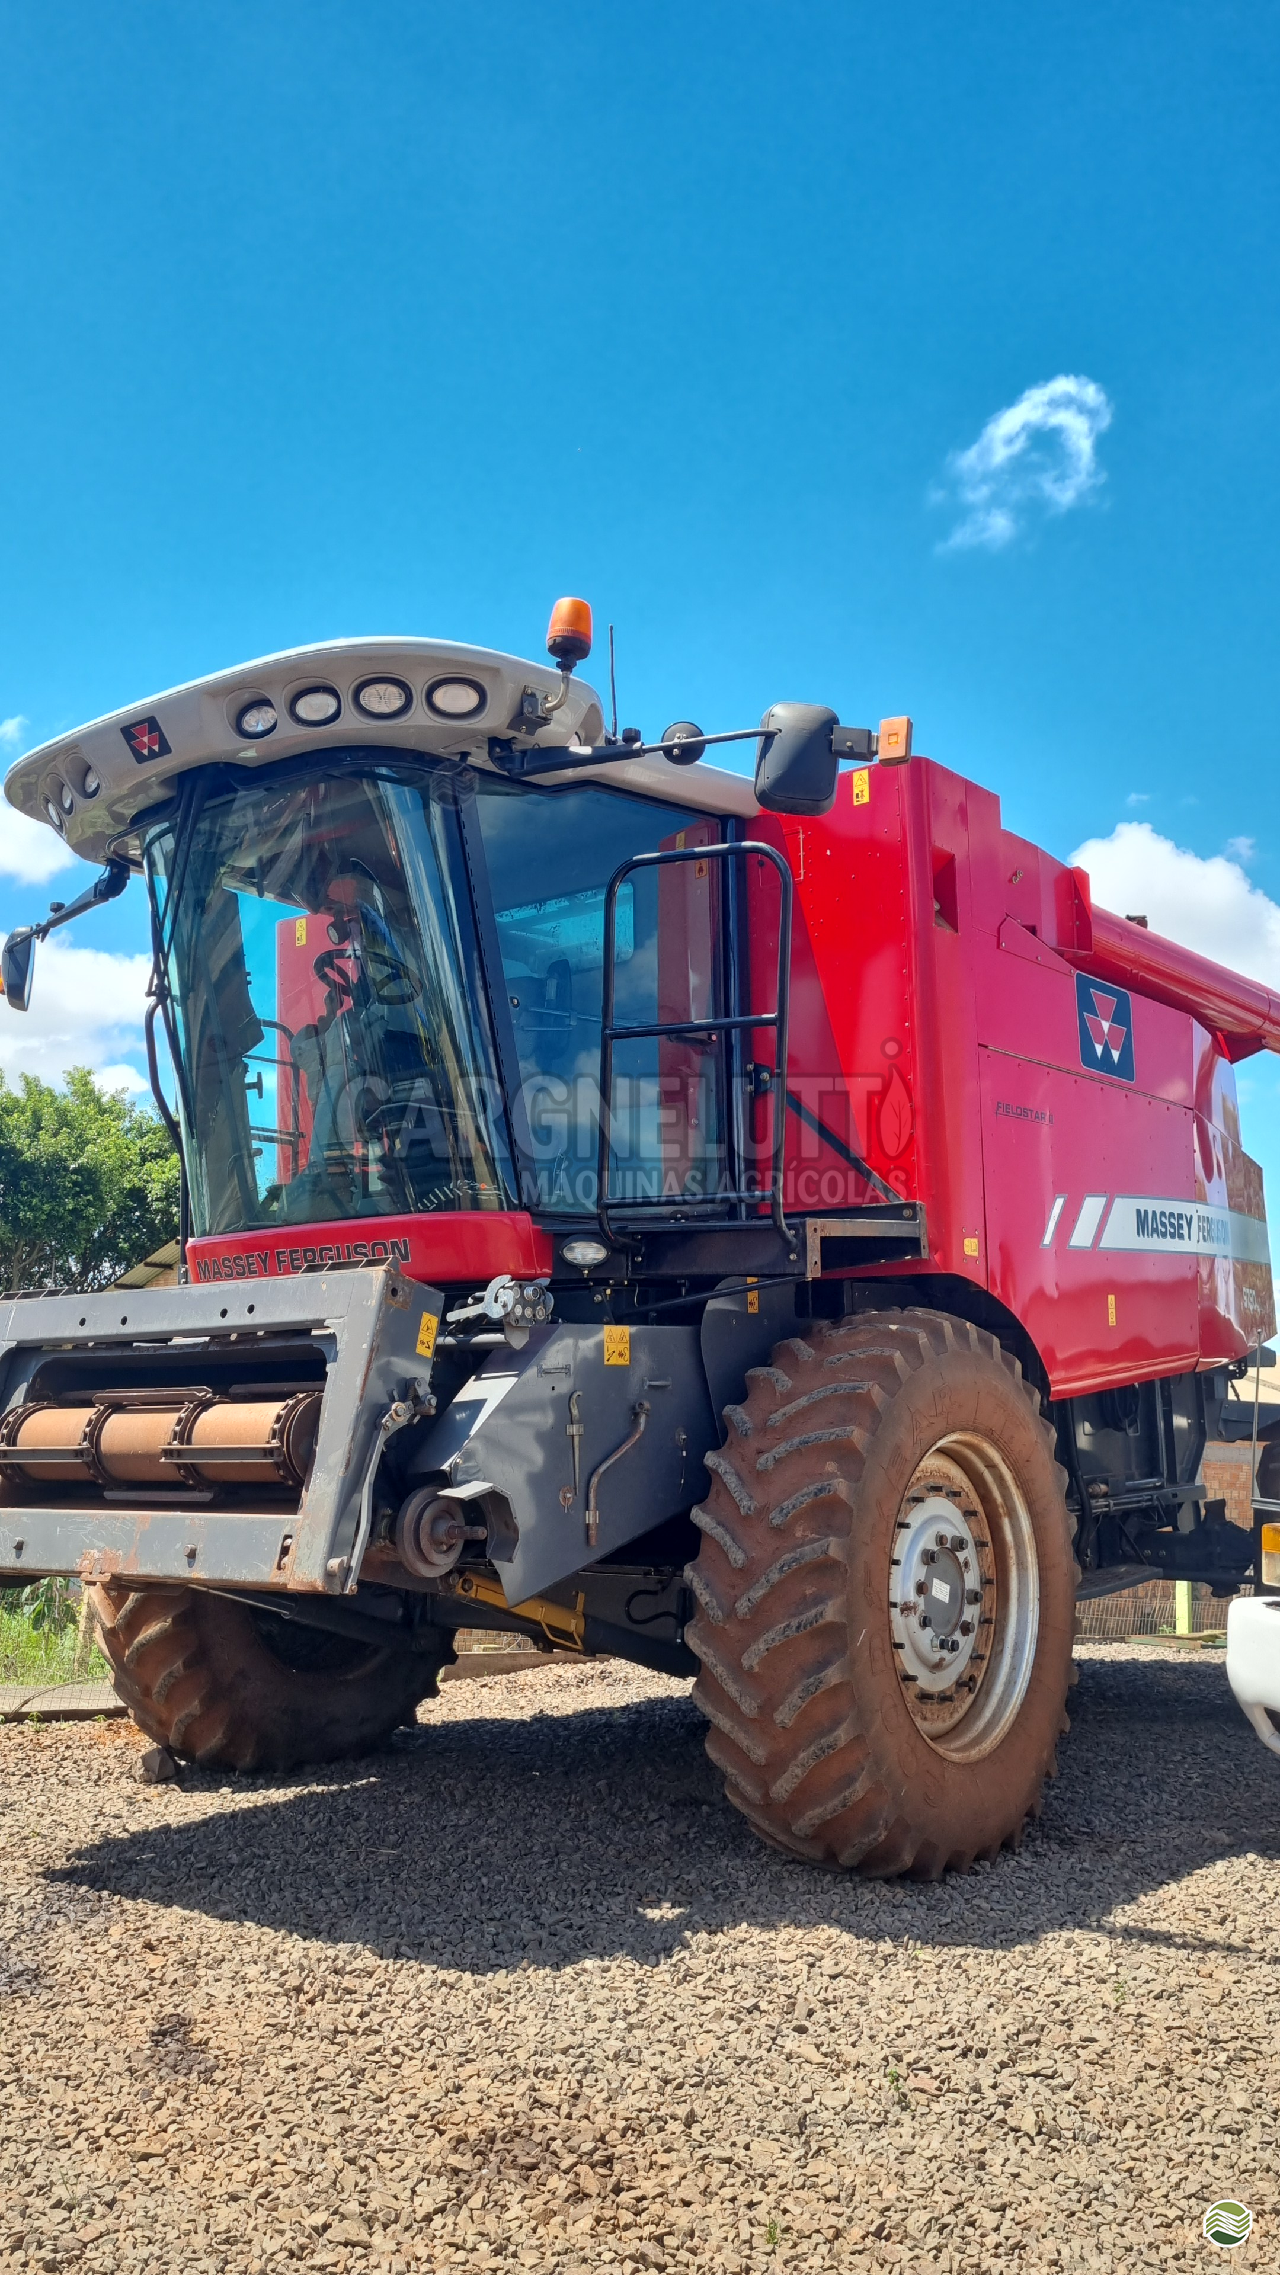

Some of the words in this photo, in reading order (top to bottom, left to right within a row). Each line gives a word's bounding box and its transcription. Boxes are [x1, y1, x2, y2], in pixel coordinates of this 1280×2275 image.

[995, 1101, 1046, 1122] FIELDSTAR
[1135, 1208, 1194, 1242] MASSEY
[196, 1251, 269, 1281] MASSEY
[275, 1238, 411, 1274] FERGUSON
